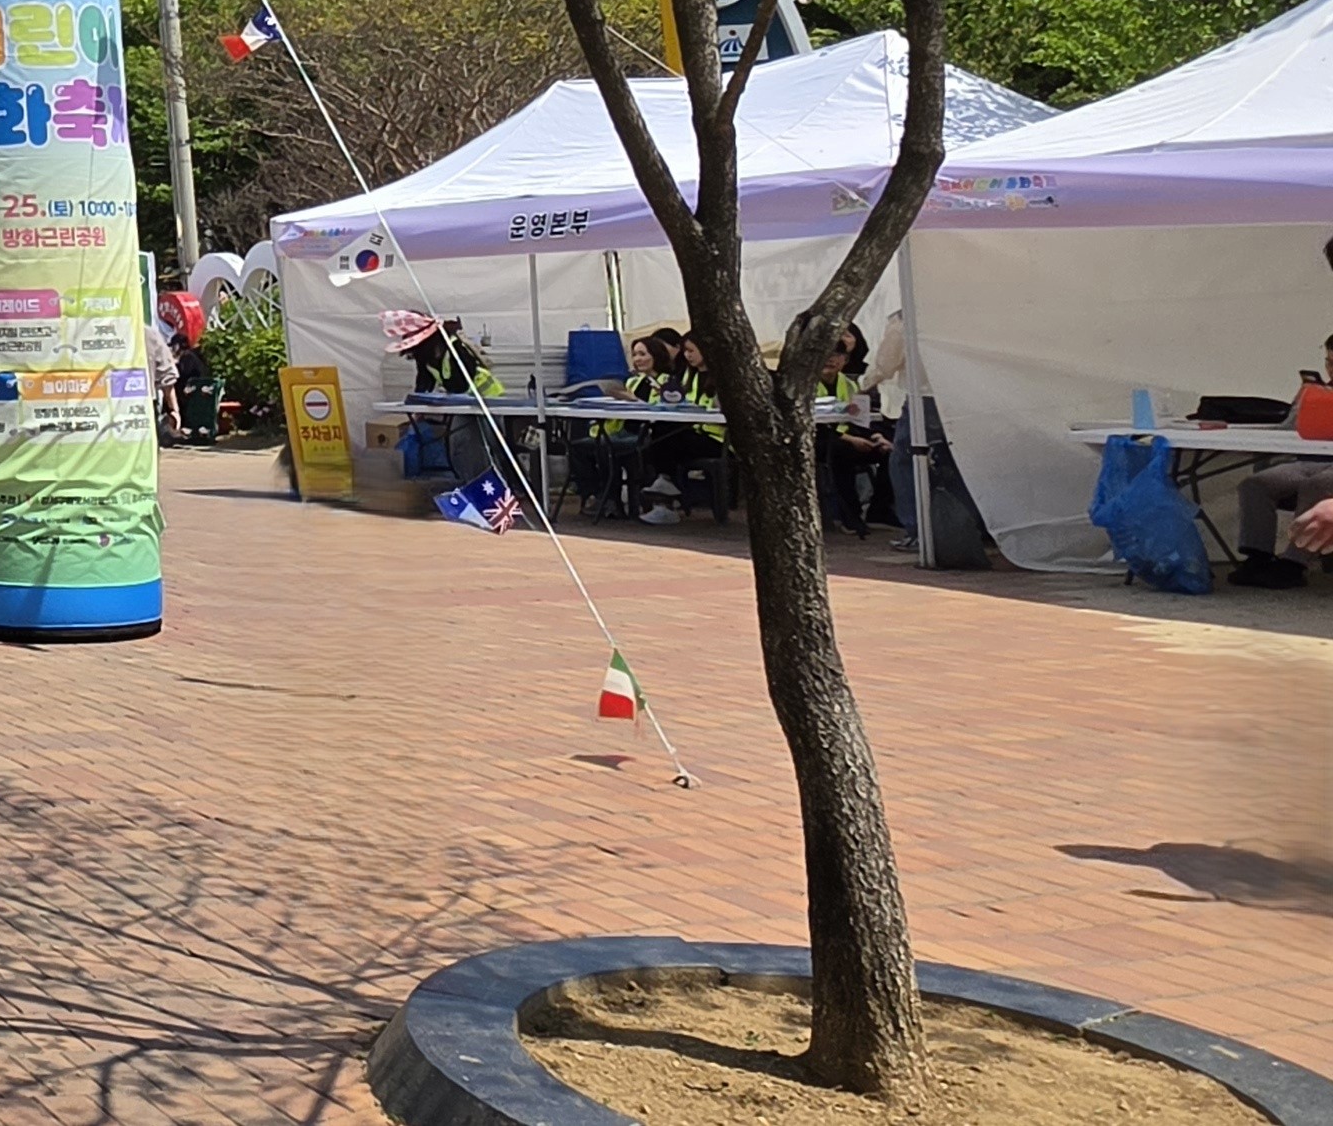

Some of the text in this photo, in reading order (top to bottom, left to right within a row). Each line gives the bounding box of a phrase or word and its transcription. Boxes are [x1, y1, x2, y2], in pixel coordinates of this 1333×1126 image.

[510, 210, 589, 239] 운영본부
[2, 226, 107, 249] 방화근린공원
[299, 425, 343, 441] 주차금지
